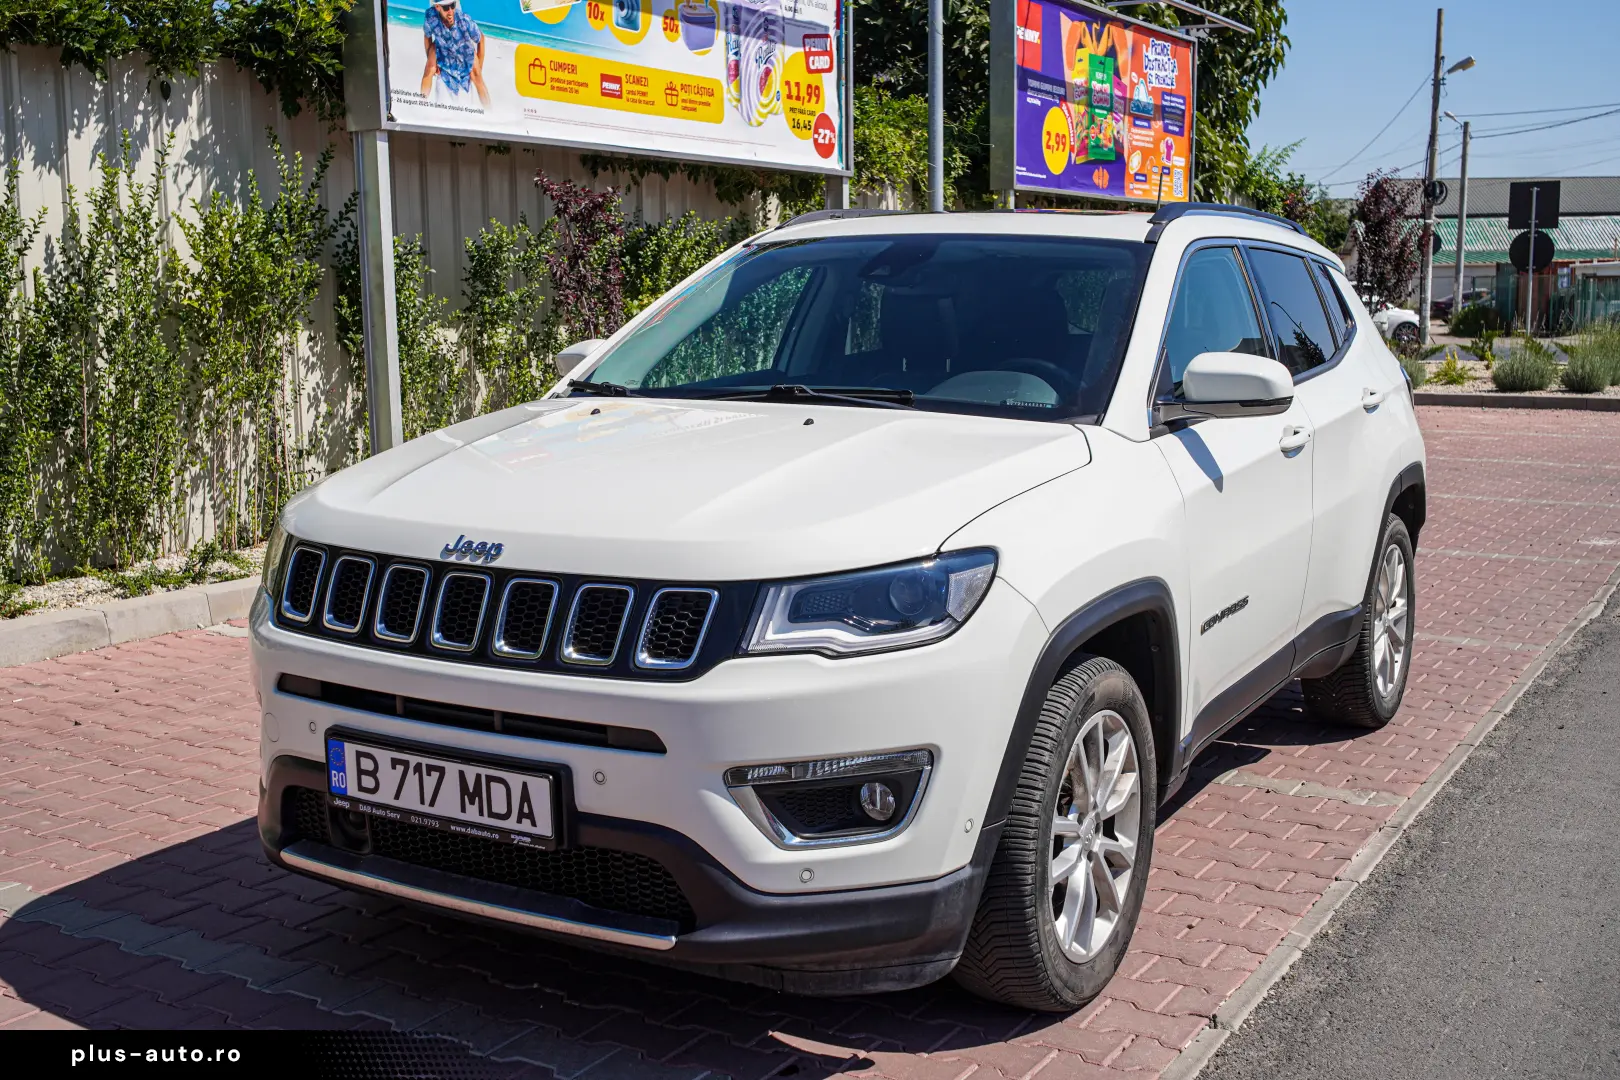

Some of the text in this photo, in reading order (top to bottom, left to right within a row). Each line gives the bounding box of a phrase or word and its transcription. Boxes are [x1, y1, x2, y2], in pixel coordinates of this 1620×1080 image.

[587, 2, 605, 21] 10x
[662, 16, 680, 34] 50x
[804, 37, 831, 51] PENNY
[549, 60, 578, 75] CUMPERI
[809, 56, 830, 69] CARD
[625, 73, 649, 87] SCANEZI
[784, 80, 821, 105] 11,99
[791, 117, 812, 131] 16,45
[814, 128, 836, 144] -27%
[1045, 130, 1067, 154] 2,99
[444, 535, 505, 563] Jeep
[331, 770, 346, 789] RO
[355, 750, 537, 828] B 717 MDA
[333, 798, 350, 809] Jeep
[359, 804, 372, 813] DAB
[372, 807, 386, 817] Auto
[386, 810, 401, 819] Serv
[410, 815, 440, 828] 021.9793
[450, 824, 500, 839] www.dabauto.ro
